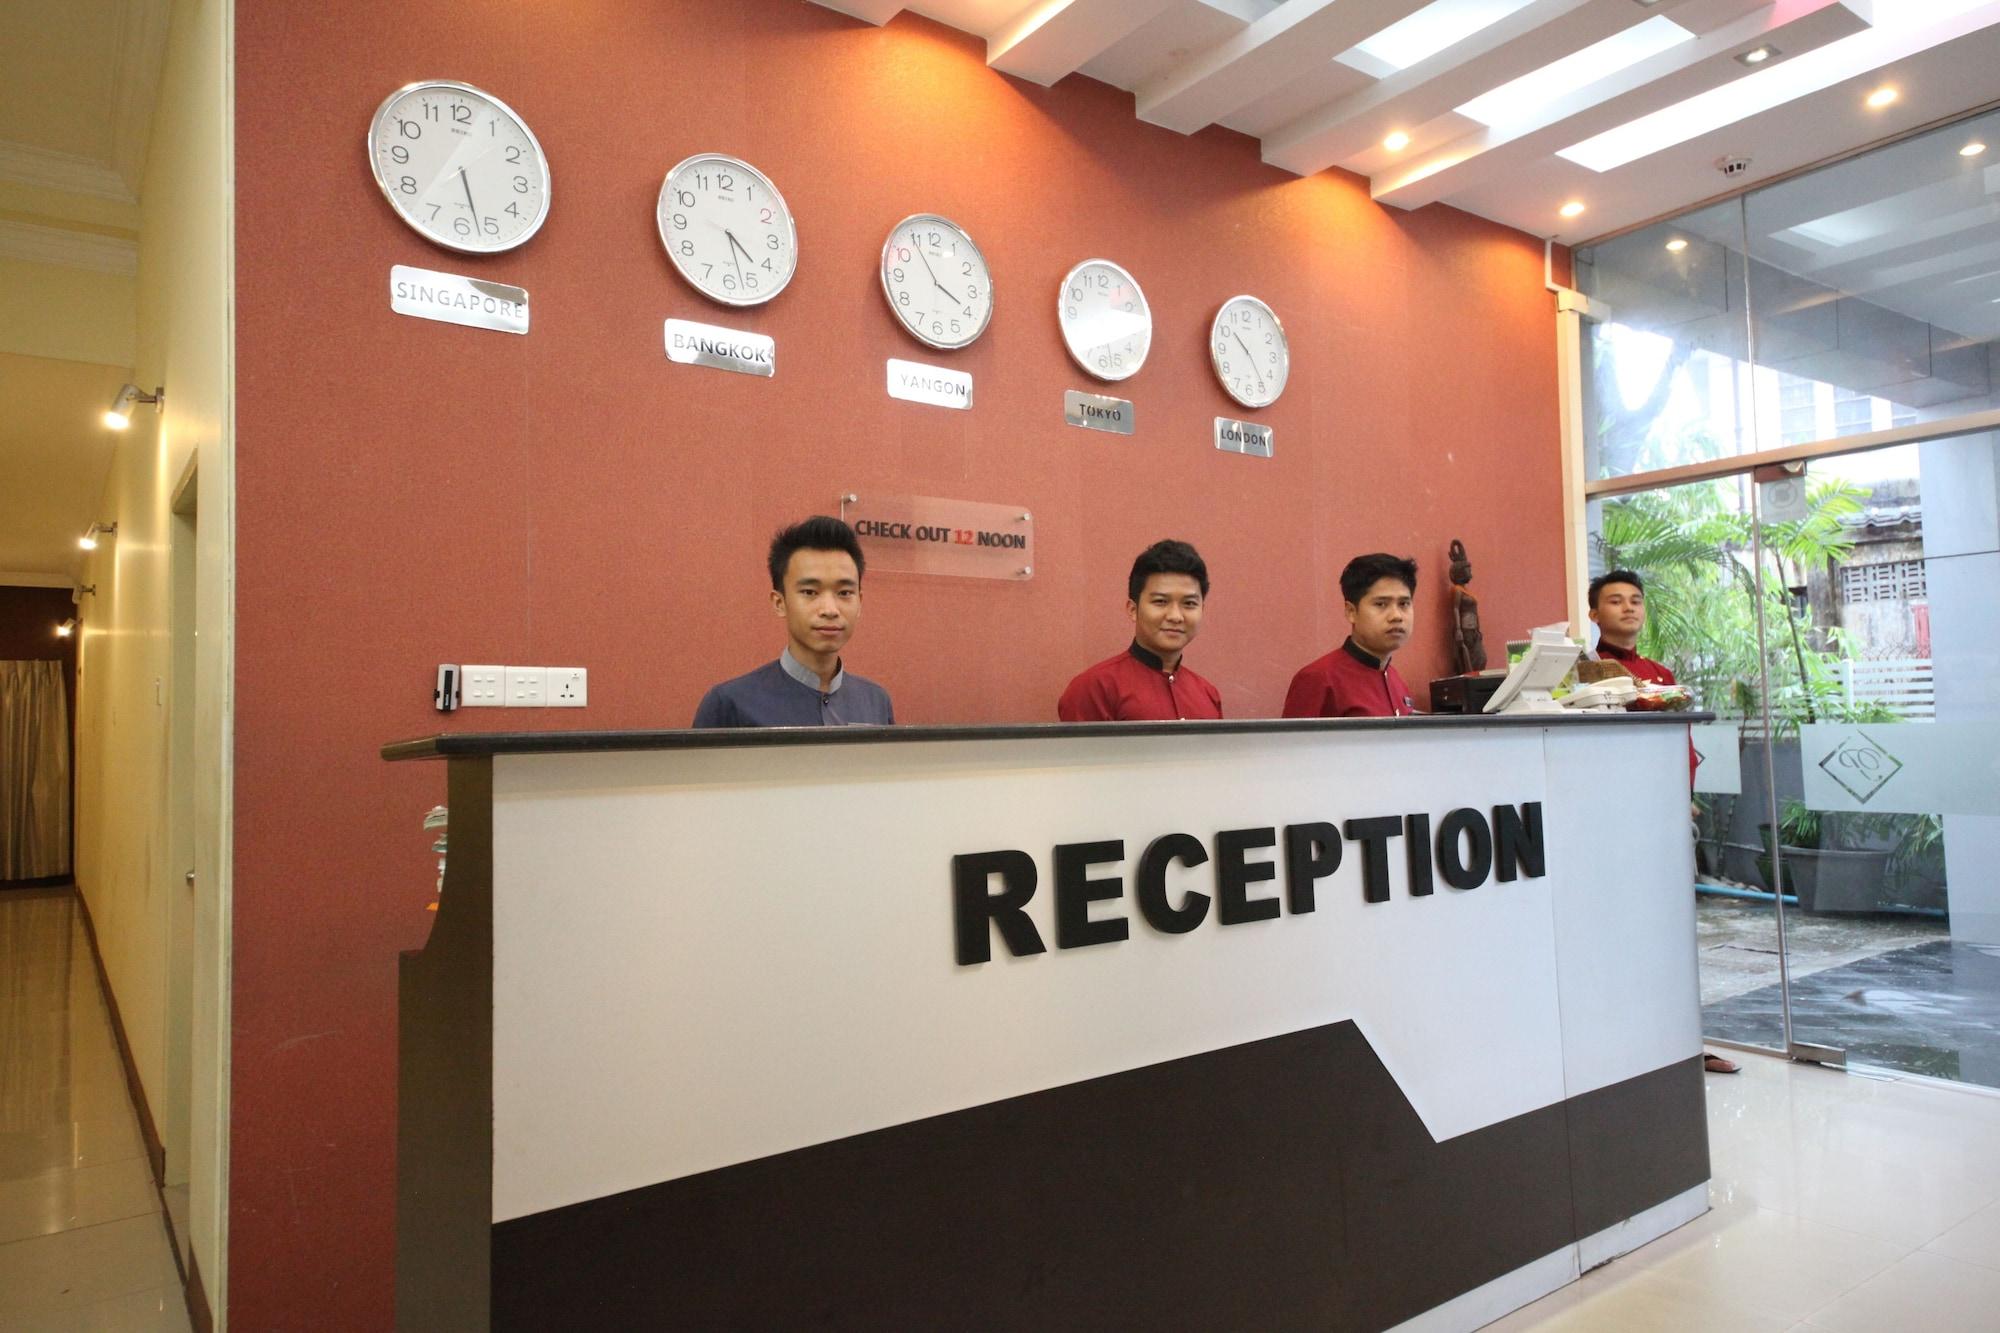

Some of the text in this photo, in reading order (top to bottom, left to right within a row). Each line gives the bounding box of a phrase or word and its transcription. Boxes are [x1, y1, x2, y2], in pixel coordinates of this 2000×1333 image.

[423, 103, 438, 122] 11
[450, 104, 472, 124] 12
[397, 119, 421, 139] 10
[392, 146, 409, 164] 9
[505, 146, 520, 164] 2
[400, 176, 417, 194] 8
[513, 176, 528, 193] 3
[696, 174, 708, 191] 11
[717, 174, 733, 191] 12
[677, 190, 695, 207] 10
[426, 203, 441, 221] 7
[504, 201, 520, 218] 4
[760, 208, 772, 224] 2
[454, 218, 470, 236] 6
[484, 217, 499, 235] 5
[673, 214, 687, 230] 9
[767, 235, 779, 250] 3
[911, 233, 921, 246] 11
[928, 233, 941, 247] 12
[682, 241, 694, 256] 8
[896, 248, 911, 262] 10
[701, 263, 713, 278] 7
[761, 258, 771, 272] 4
[962, 262, 972, 276] 2
[723, 274, 736, 290] 6
[746, 272, 758, 288] 5
[893, 268, 904, 282] 9
[1083, 275, 1092, 288] 11
[1098, 274, 1109, 288] 12
[900, 292, 910, 306] 8
[968, 285, 978, 299] 3
[1072, 287, 1083, 302] 10
[397, 282, 523, 318] SINGAPORE
[916, 312, 924, 325] 7
[963, 306, 972, 318] 4
[1068, 306, 1077, 319] 9
[1230, 310, 1238, 324] 11
[1242, 311, 1251, 323] 12
[933, 321, 943, 335] 6
[951, 320, 960, 333] 5
[1220, 325, 1230, 338] 10
[1265, 333, 1273, 344] 2
[674, 333, 765, 363] BANGKOK
[1219, 343, 1226, 354] 9
[1098, 354, 1107, 368] 6
[1113, 354, 1122, 367] 5
[1270, 352, 1277, 363] 3
[1223, 362, 1230, 374] 8
[1267, 370, 1273, 380] 4
[901, 374, 965, 396] YANGON
[1234, 377, 1240, 389] 7
[1246, 384, 1253, 396] 6
[1258, 382, 1265, 393] 5
[1080, 404, 1121, 421] TOKYO
[1221, 428, 1265, 446] LONDON
[855, 520, 1026, 549] CHECK OUT 12 NOON
[954, 802, 1546, 966] RECEPTION
